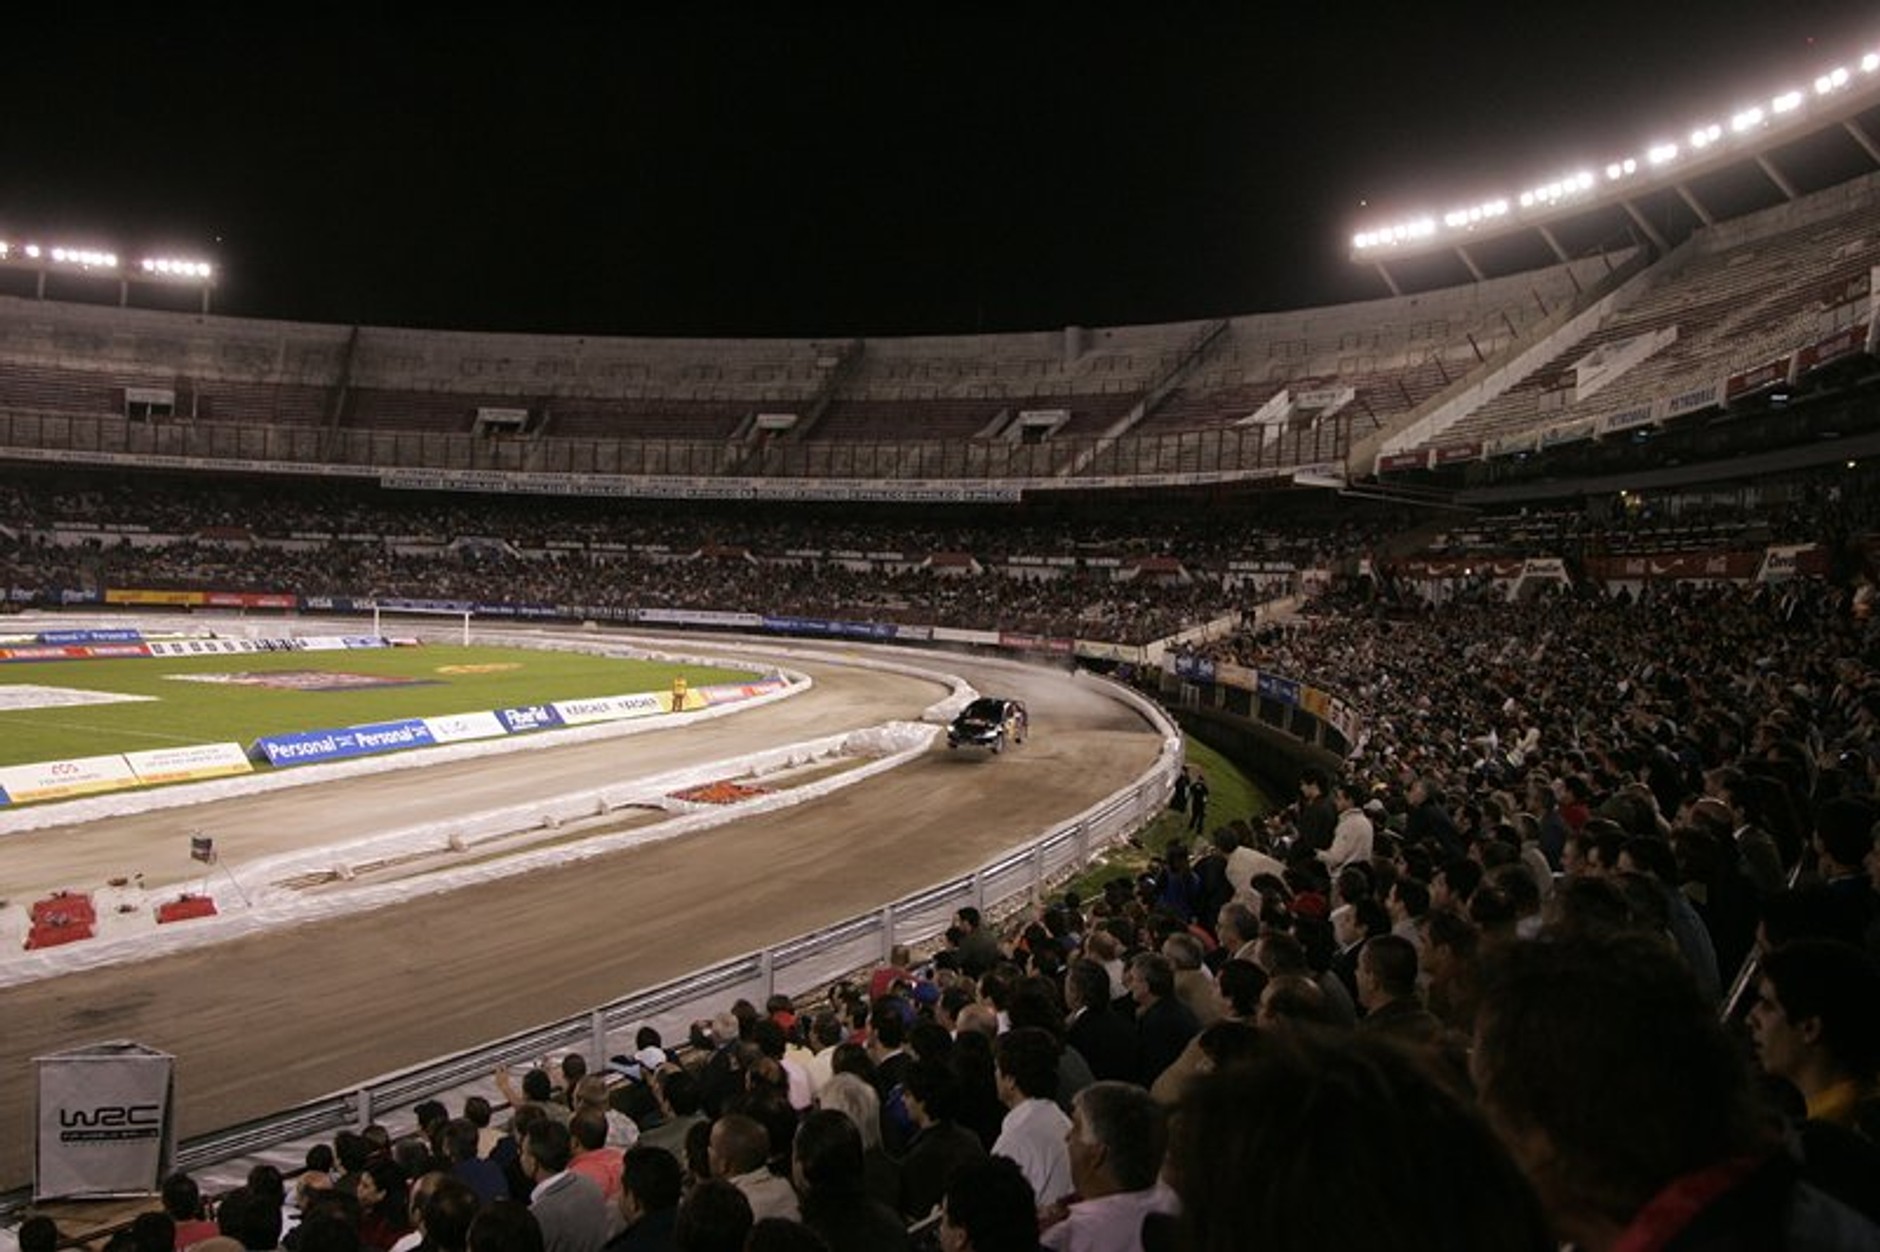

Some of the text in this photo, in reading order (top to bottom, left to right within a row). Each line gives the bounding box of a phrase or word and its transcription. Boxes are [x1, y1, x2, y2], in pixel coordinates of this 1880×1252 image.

[268, 735, 337, 760] Personal
[355, 725, 415, 749] Personal
[60, 1105, 159, 1128] WRC
